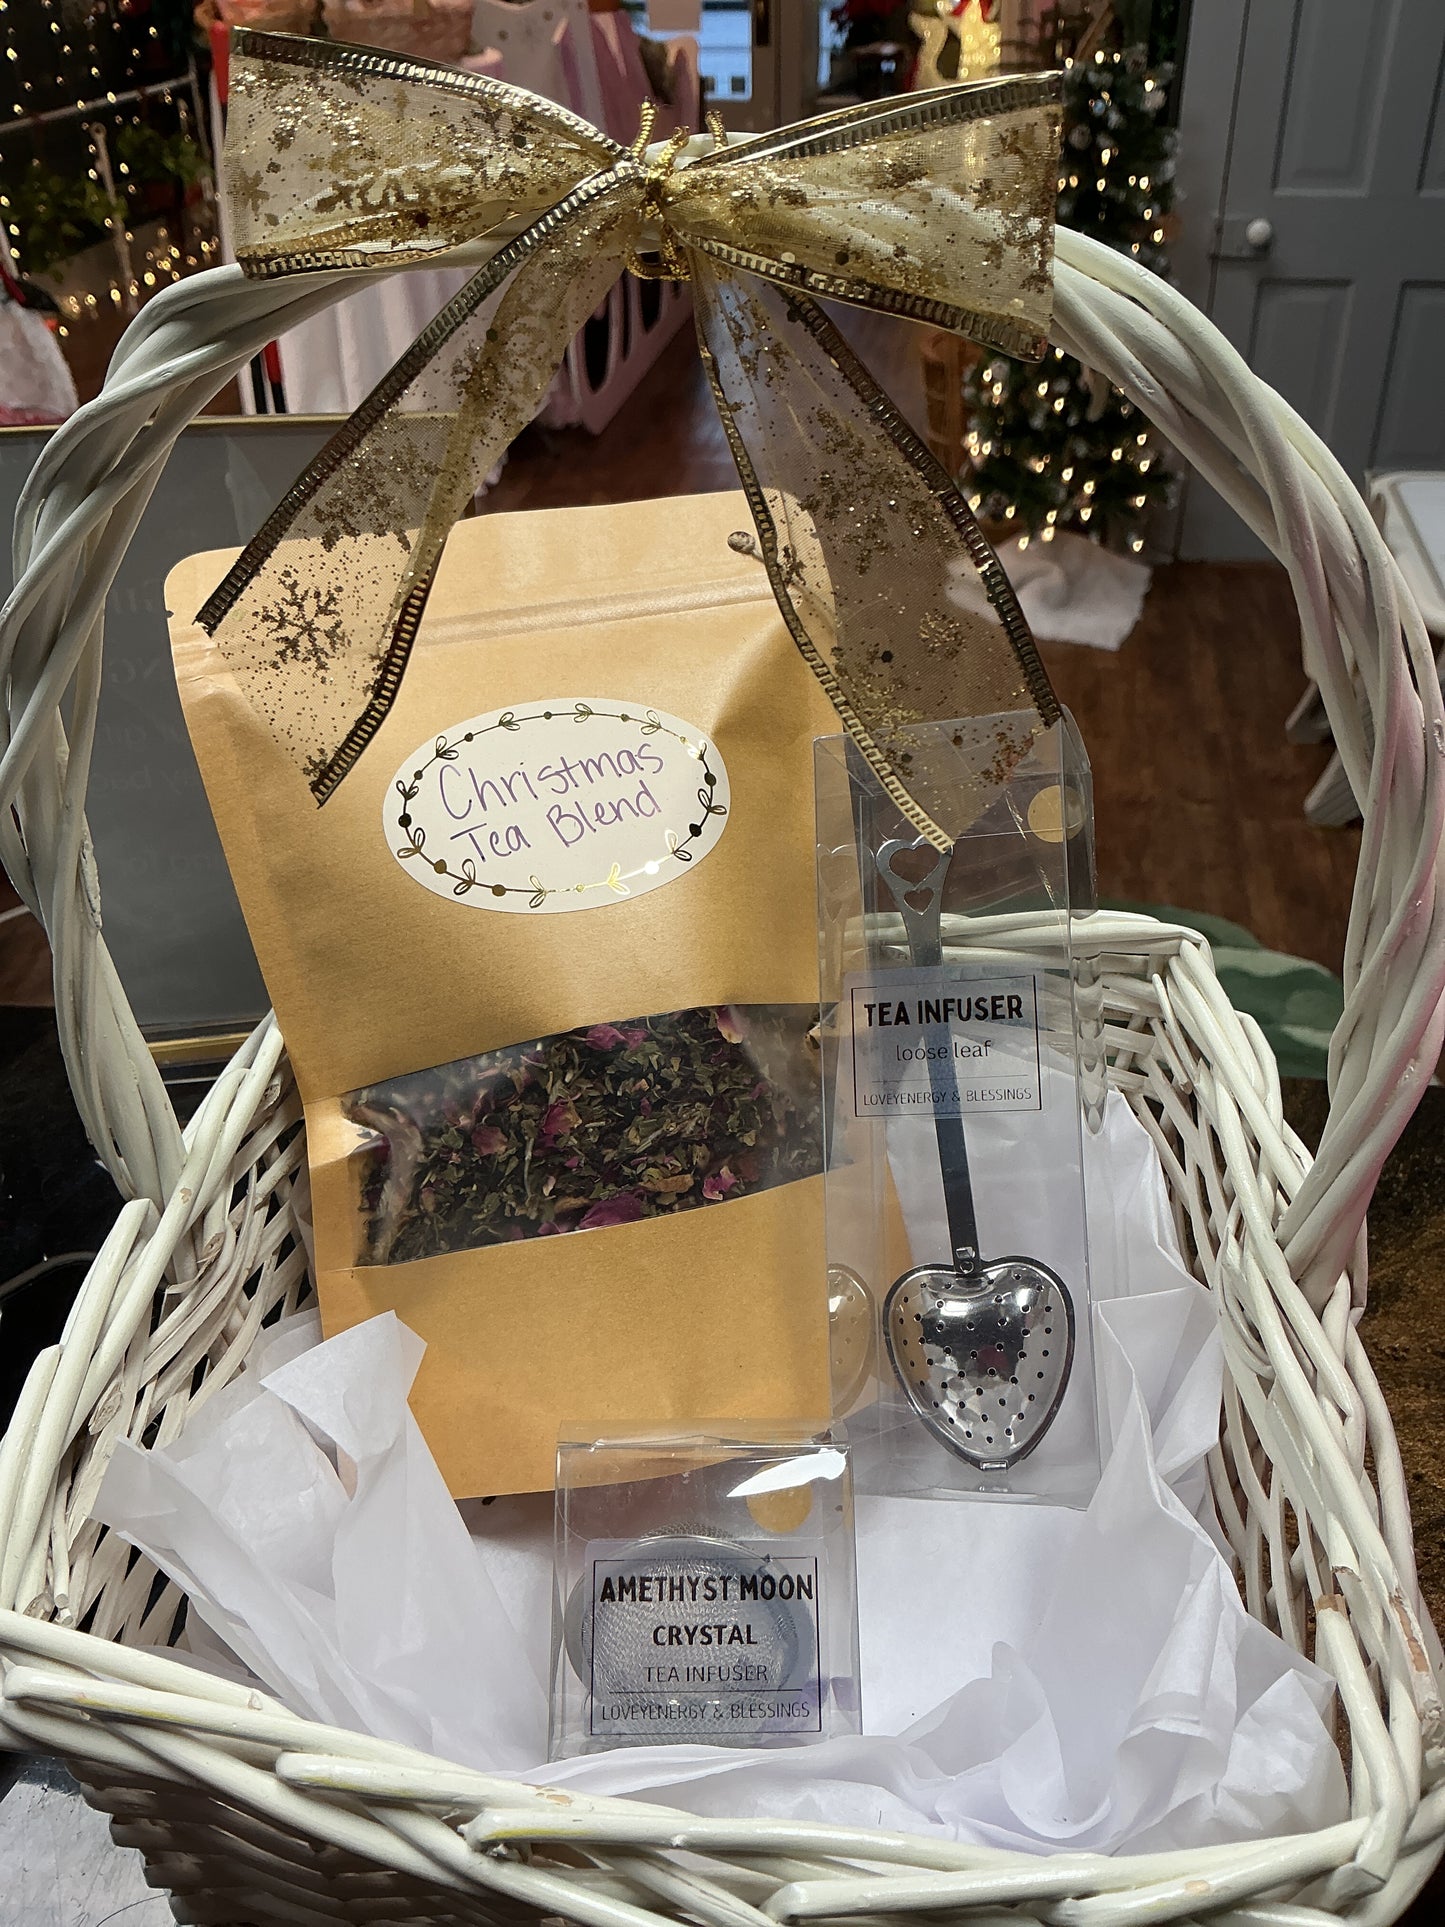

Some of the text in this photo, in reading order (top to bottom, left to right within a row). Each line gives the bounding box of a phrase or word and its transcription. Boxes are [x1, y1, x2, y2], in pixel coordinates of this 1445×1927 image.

[438, 742, 664, 820] Christmas
[450, 779, 662, 863] Tea Blend
[863, 994, 1024, 1028] TEA INFUSER
[896, 1039, 992, 1062] loose leaf
[863, 1087, 1032, 1106] LOVEYENERGY & BLESSINGS
[600, 1573, 814, 1603] AMETHYST MOON
[652, 1624, 758, 1647] CRYSTAL
[643, 1664, 768, 1683] TEA INFUSER
[602, 1701, 810, 1721] LOVEYENERGY & BLESSINGS
